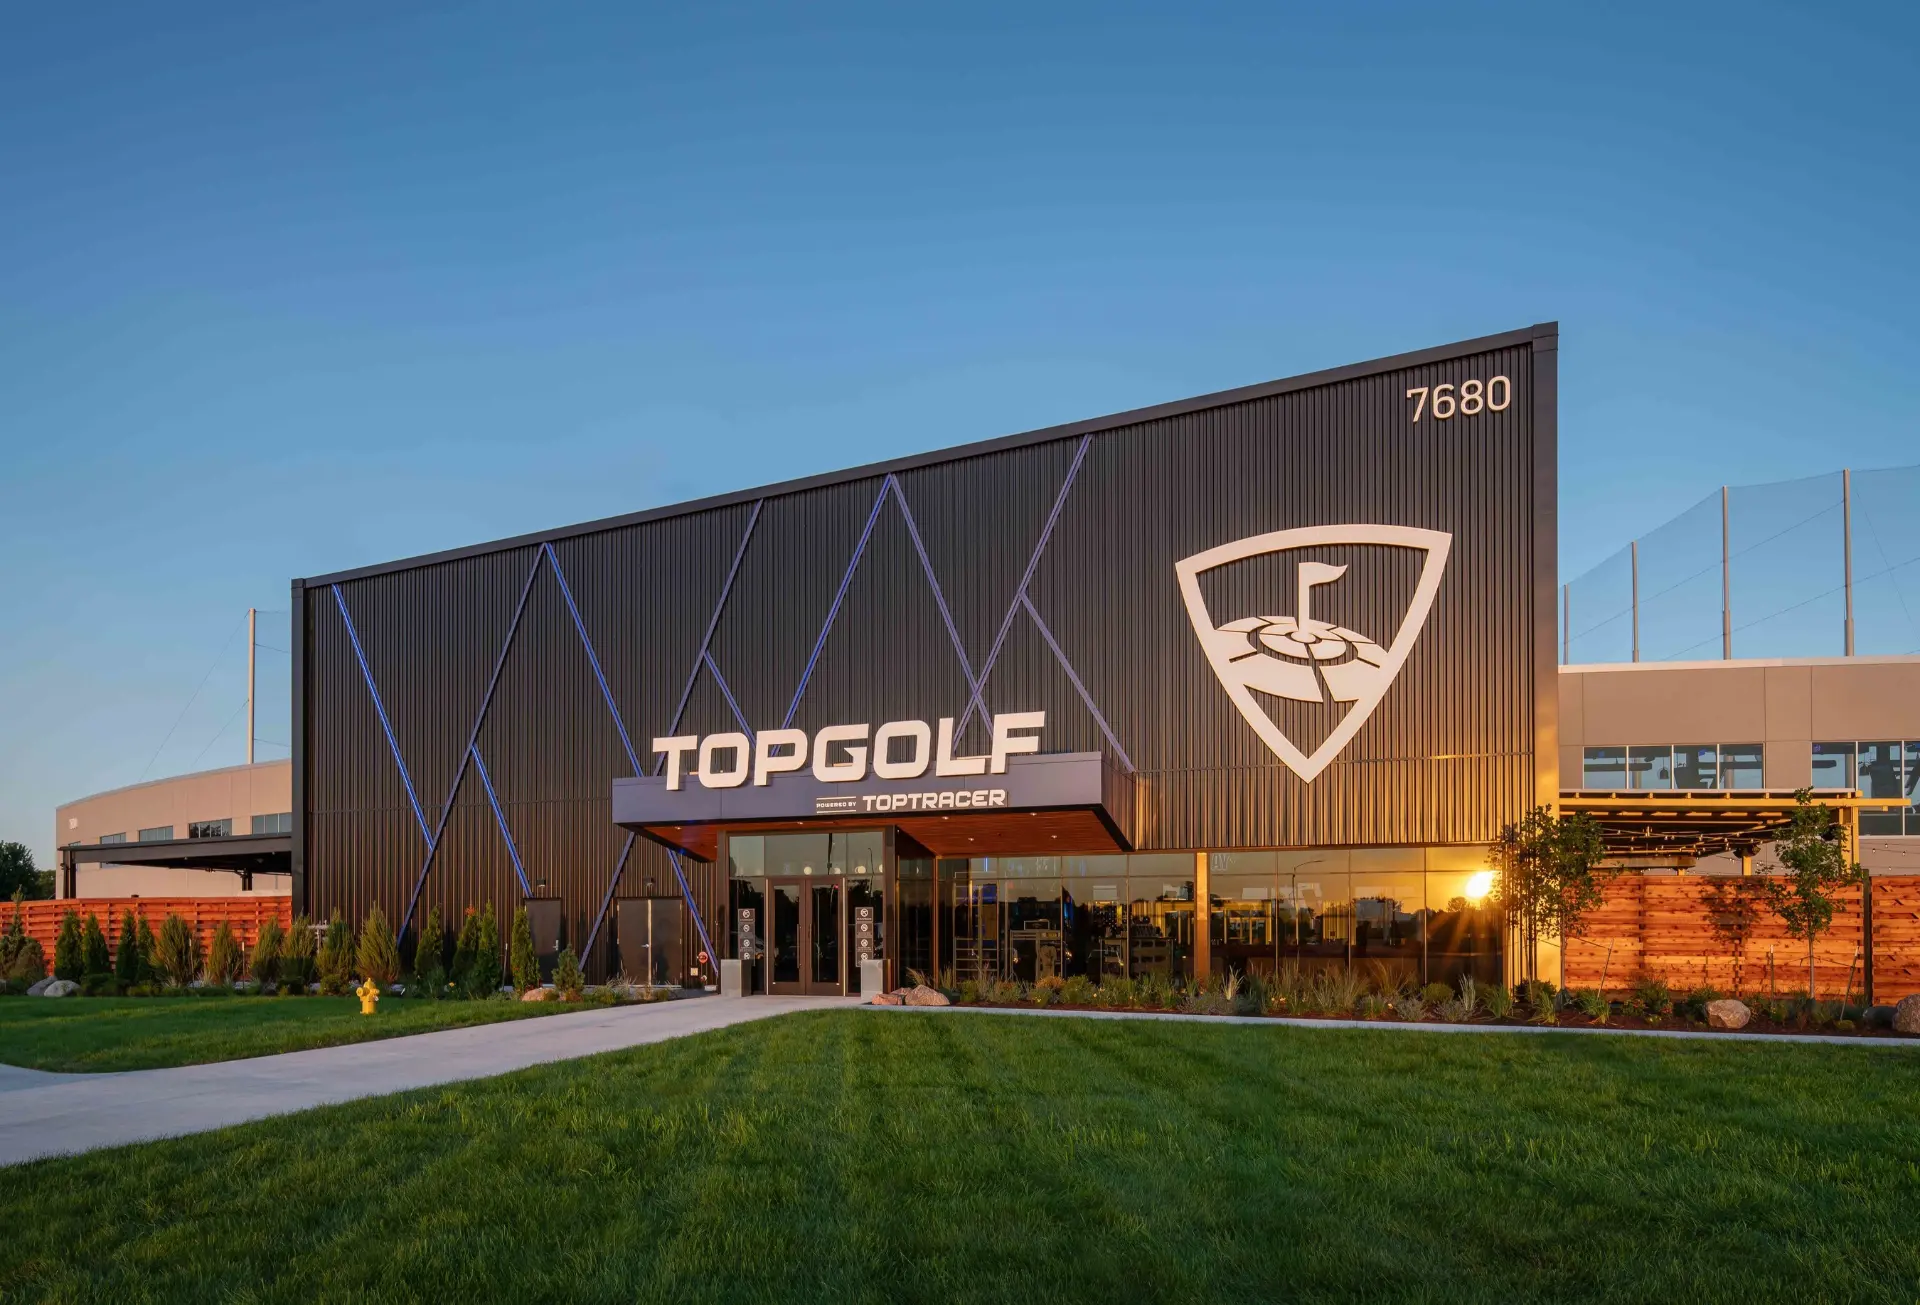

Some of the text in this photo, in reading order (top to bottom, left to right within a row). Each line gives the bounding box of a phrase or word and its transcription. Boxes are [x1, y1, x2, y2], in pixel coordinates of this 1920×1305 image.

[1406, 375, 1511, 423] 7680
[652, 711, 1046, 791] TOPGOLF
[862, 789, 1007, 812] TOPTRACER
